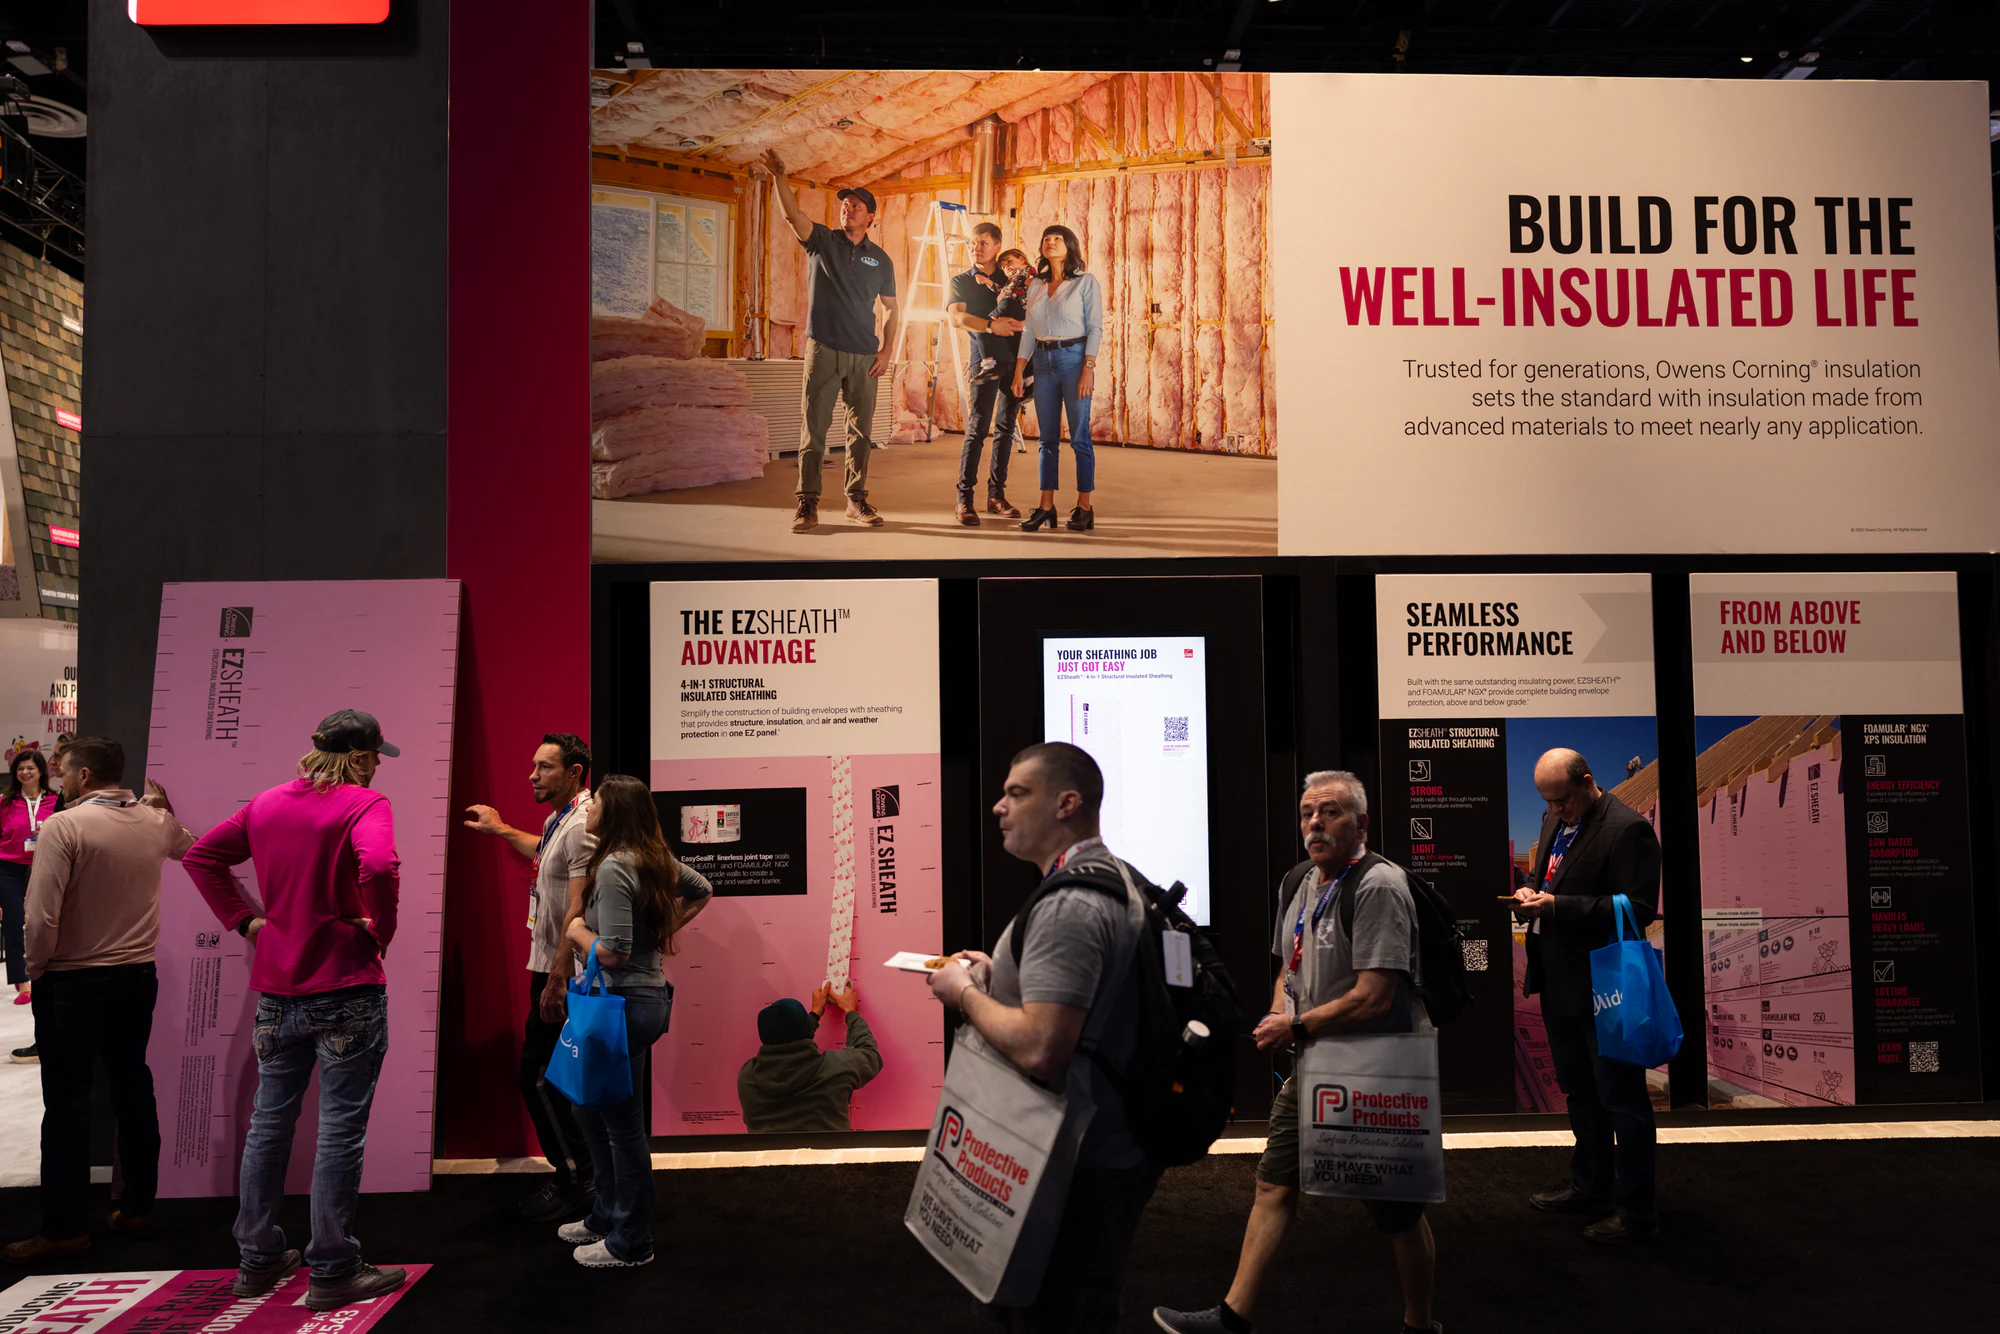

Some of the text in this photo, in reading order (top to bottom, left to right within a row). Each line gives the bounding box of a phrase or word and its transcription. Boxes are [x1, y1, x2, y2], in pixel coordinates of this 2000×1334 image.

[1508, 195, 1916, 255] BUILD FOR THE
[1339, 266, 1918, 328] WELL-INSULATED LIFE
[1403, 360, 1482, 379] Trusted
[1488, 360, 1518, 379] for
[1524, 361, 1650, 385] generations,
[1656, 361, 1726, 379] Owens
[1824, 361, 1921, 379] insulation
[1472, 388, 1923, 408] sets the standard with insulation made from
[1404, 416, 1924, 441] advanced materials to meet nearly any application.
[1406, 602, 1520, 628] SEAMLESS
[1720, 600, 1861, 625] FROM ABOVE
[223, 609, 238, 637] OWENS CORNING
[680, 610, 723, 635] THE
[1407, 631, 1574, 656] PERFORMANCE
[1721, 629, 1847, 654] AND BELOW
[681, 639, 816, 666] ADVANTAGE
[1057, 648, 1157, 660] YOUR SHEATHING JOB
[64, 666, 77, 681] OU
[1057, 660, 1126, 673] JUST GOT EASY
[1148, 672, 1173, 680] Sheathing
[1407, 678, 1423, 686] Built
[1424, 678, 1440, 686] with
[1440, 678, 1453, 686] the
[1474, 678, 1517, 687] outstanding
[1517, 677, 1552, 687] insulating
[1552, 678, 1576, 686] power,
[50, 683, 68, 698] AND
[680, 678, 765, 690] 4-IN-1 STRUCTURAL
[204, 648, 220, 741] STRUCTURAL INSULATED SHEATHING
[680, 690, 777, 702] INSULATED SHEATHING
[1407, 688, 1421, 696] and
[1488, 687, 1515, 697] provide
[1515, 687, 1549, 697] complete
[1549, 686, 1577, 696] building
[1577, 687, 1610, 696] envelope
[41, 700, 78, 716] MAKE TH
[1407, 698, 1505, 708] protection, above and below
[680, 704, 903, 719] Simplify the construction of building envelopes with sheathing
[47, 718, 77, 734] A BETT
[680, 715, 879, 729] that provides structure, insulation, and air and weather
[680, 729, 755, 740] protection in one EZ
[1448, 727, 1500, 738] STRUCTURAL
[1863, 734, 1927, 745] XPS INSULATION
[1409, 738, 1496, 749] INSULATED SHEATHING
[1409, 785, 1443, 797] STRONG
[1866, 780, 1940, 791] ENERGY EFFICIENCY
[1411, 843, 1436, 855] LIGHT
[1868, 837, 1913, 847] LOW WATER
[716, 852, 790, 862] linerless joint tape seals
[1869, 847, 1919, 858] ABSORPTION
[774, 860, 790, 868] NGX
[877, 824, 898, 914] EZ SHEATH
[1871, 911, 1907, 922] HANDLES
[1872, 922, 1925, 933] HEAVY LOADS
[1875, 986, 1909, 997] LIFETIME
[1875, 997, 1921, 1008] GUARANTEE
[1812, 1012, 1826, 1022] 250
[1877, 1042, 1903, 1053] LEARN
[1352, 1090, 1429, 1110] Protective
[1352, 1109, 1420, 1129] Products
[963, 1128, 1029, 1187] Protective
[1314, 1159, 1415, 1176] WE HAVE WHAT
[956, 1151, 1012, 1203] Products
[1314, 1170, 1340, 1183] YOU
[919, 1204, 933, 1227] YOU
[922, 1190, 934, 1209] WE
[932, 1202, 953, 1231] HAVE
[952, 1222, 984, 1255] WHAT
[154, 1276, 226, 1312] PANEL
